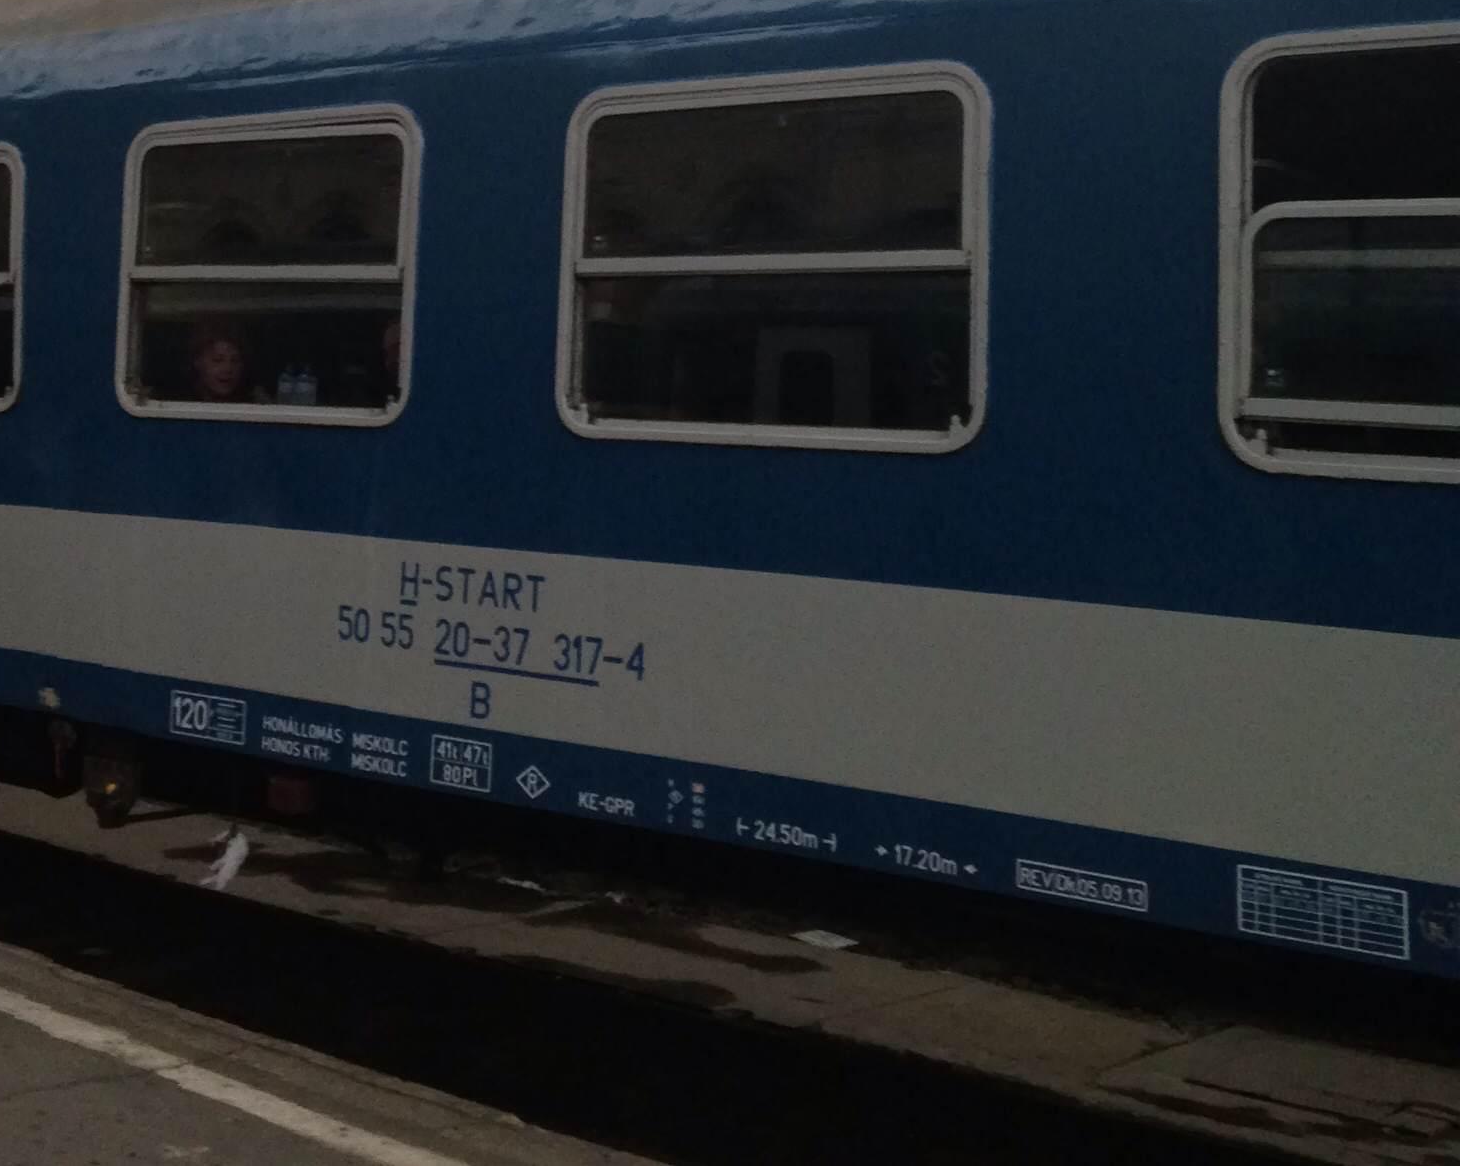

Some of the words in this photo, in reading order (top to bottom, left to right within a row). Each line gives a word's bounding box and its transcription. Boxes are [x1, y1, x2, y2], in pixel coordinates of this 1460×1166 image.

[400, 561, 546, 612] H-START
[338, 604, 370, 642] 50
[381, 611, 414, 649] 55
[434, 618, 530, 666] 20-37
[554, 633, 645, 682] 317-4
[174, 697, 207, 730] 120
[470, 681, 491, 719] B
[260, 736, 301, 758] HONOS
[350, 753, 408, 778] MISKOLC
[351, 732, 409, 757] MISKOLC
[577, 791, 636, 817] KE-GPR
[894, 844, 958, 876] 17.20m
